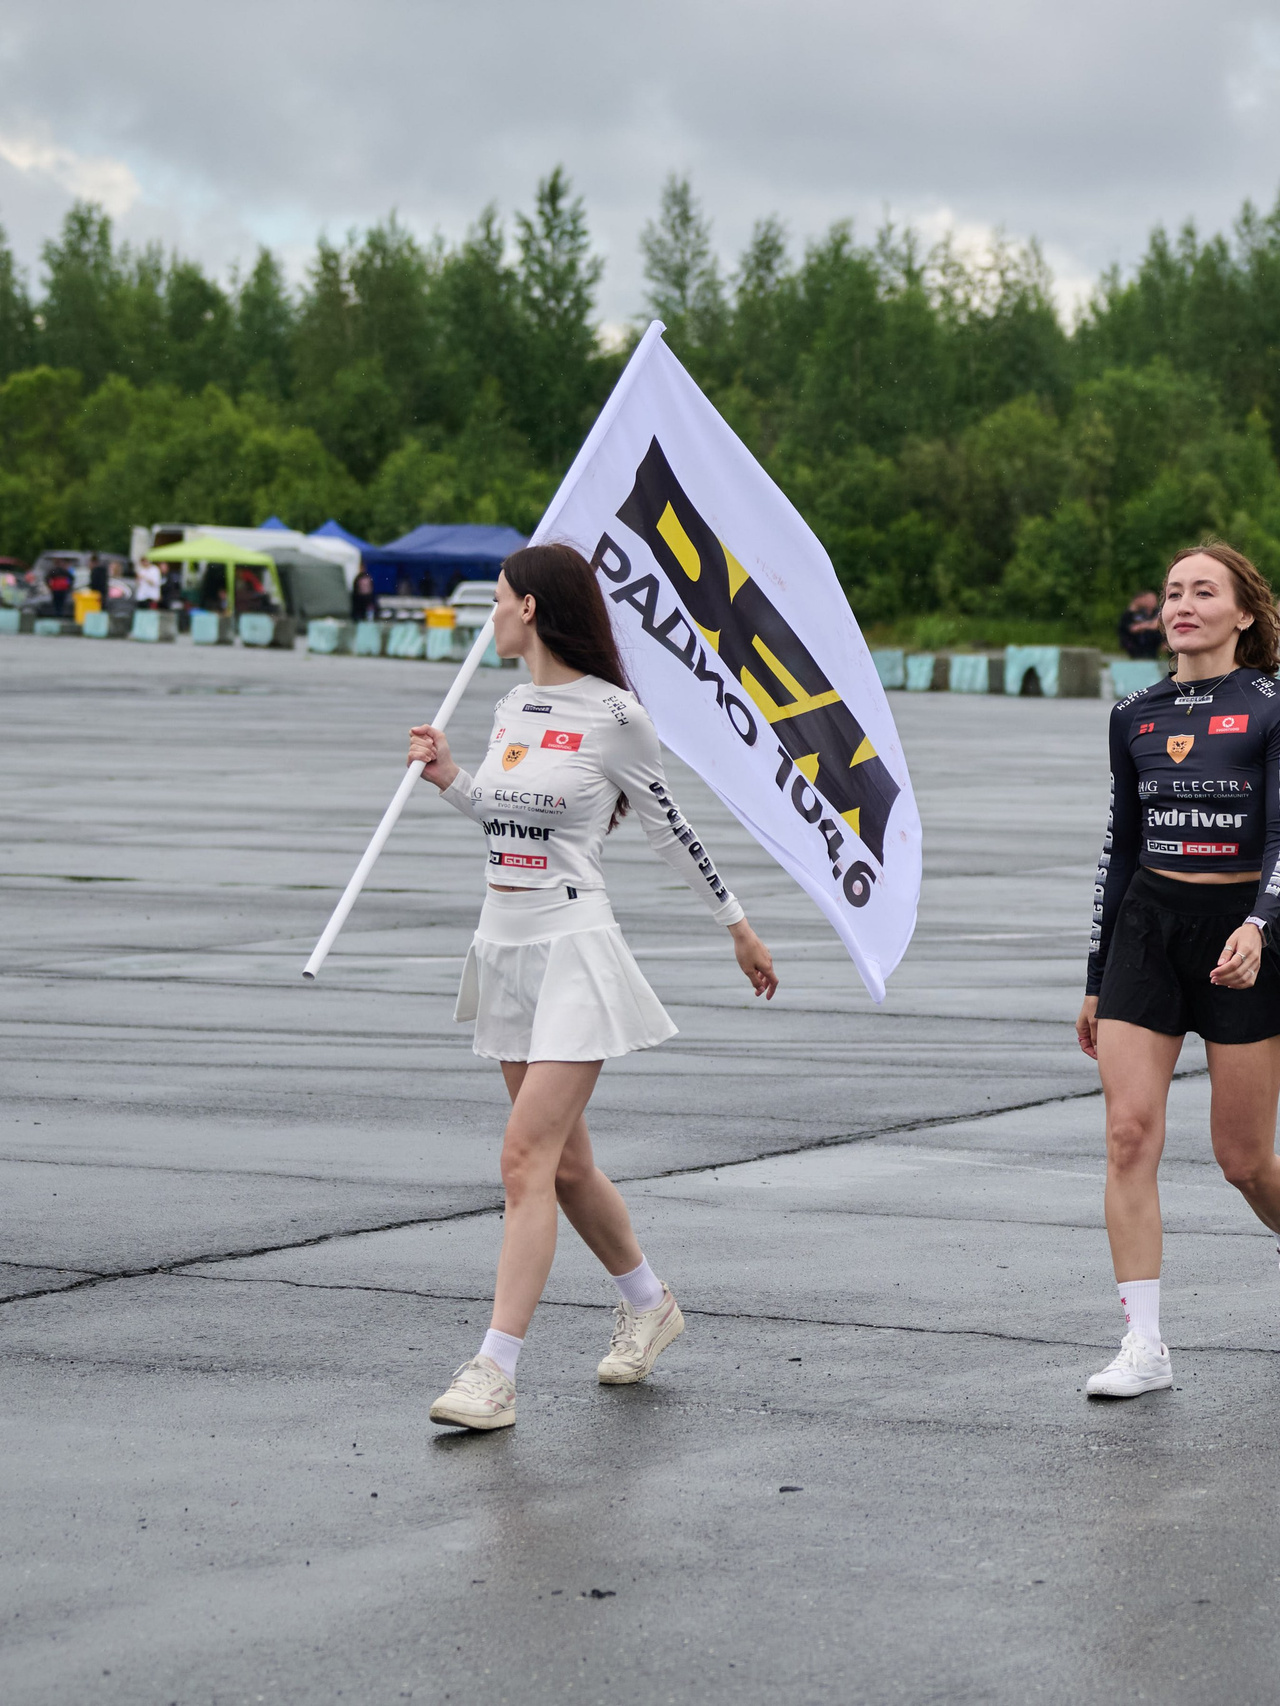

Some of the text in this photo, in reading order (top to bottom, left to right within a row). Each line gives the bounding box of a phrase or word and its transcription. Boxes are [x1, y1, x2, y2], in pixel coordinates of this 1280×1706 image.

[615, 434, 901, 866] DFM
[590, 532, 877, 908] РАДИО 104.6
[1172, 780, 1253, 792] ELECTRA
[494, 789, 567, 809] ELECTRA
[527, 806, 564, 815] COMMUNITY
